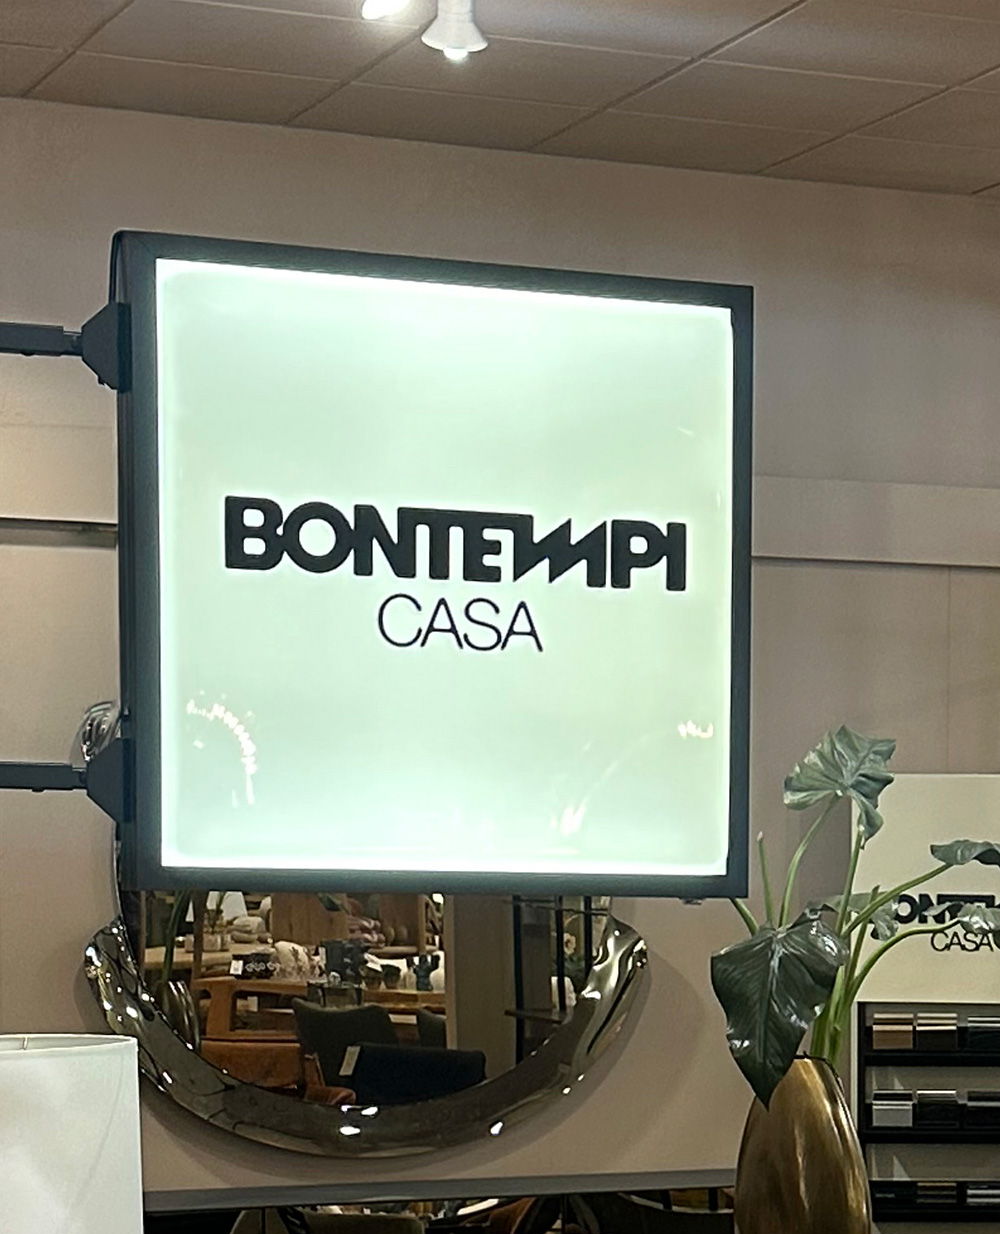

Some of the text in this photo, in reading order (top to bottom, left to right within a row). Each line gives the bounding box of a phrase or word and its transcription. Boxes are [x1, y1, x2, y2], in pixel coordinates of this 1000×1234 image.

[225, 496, 686, 591] BONTEMPI
[378, 593, 543, 652] CASA
[931, 931, 994, 951] CASA
